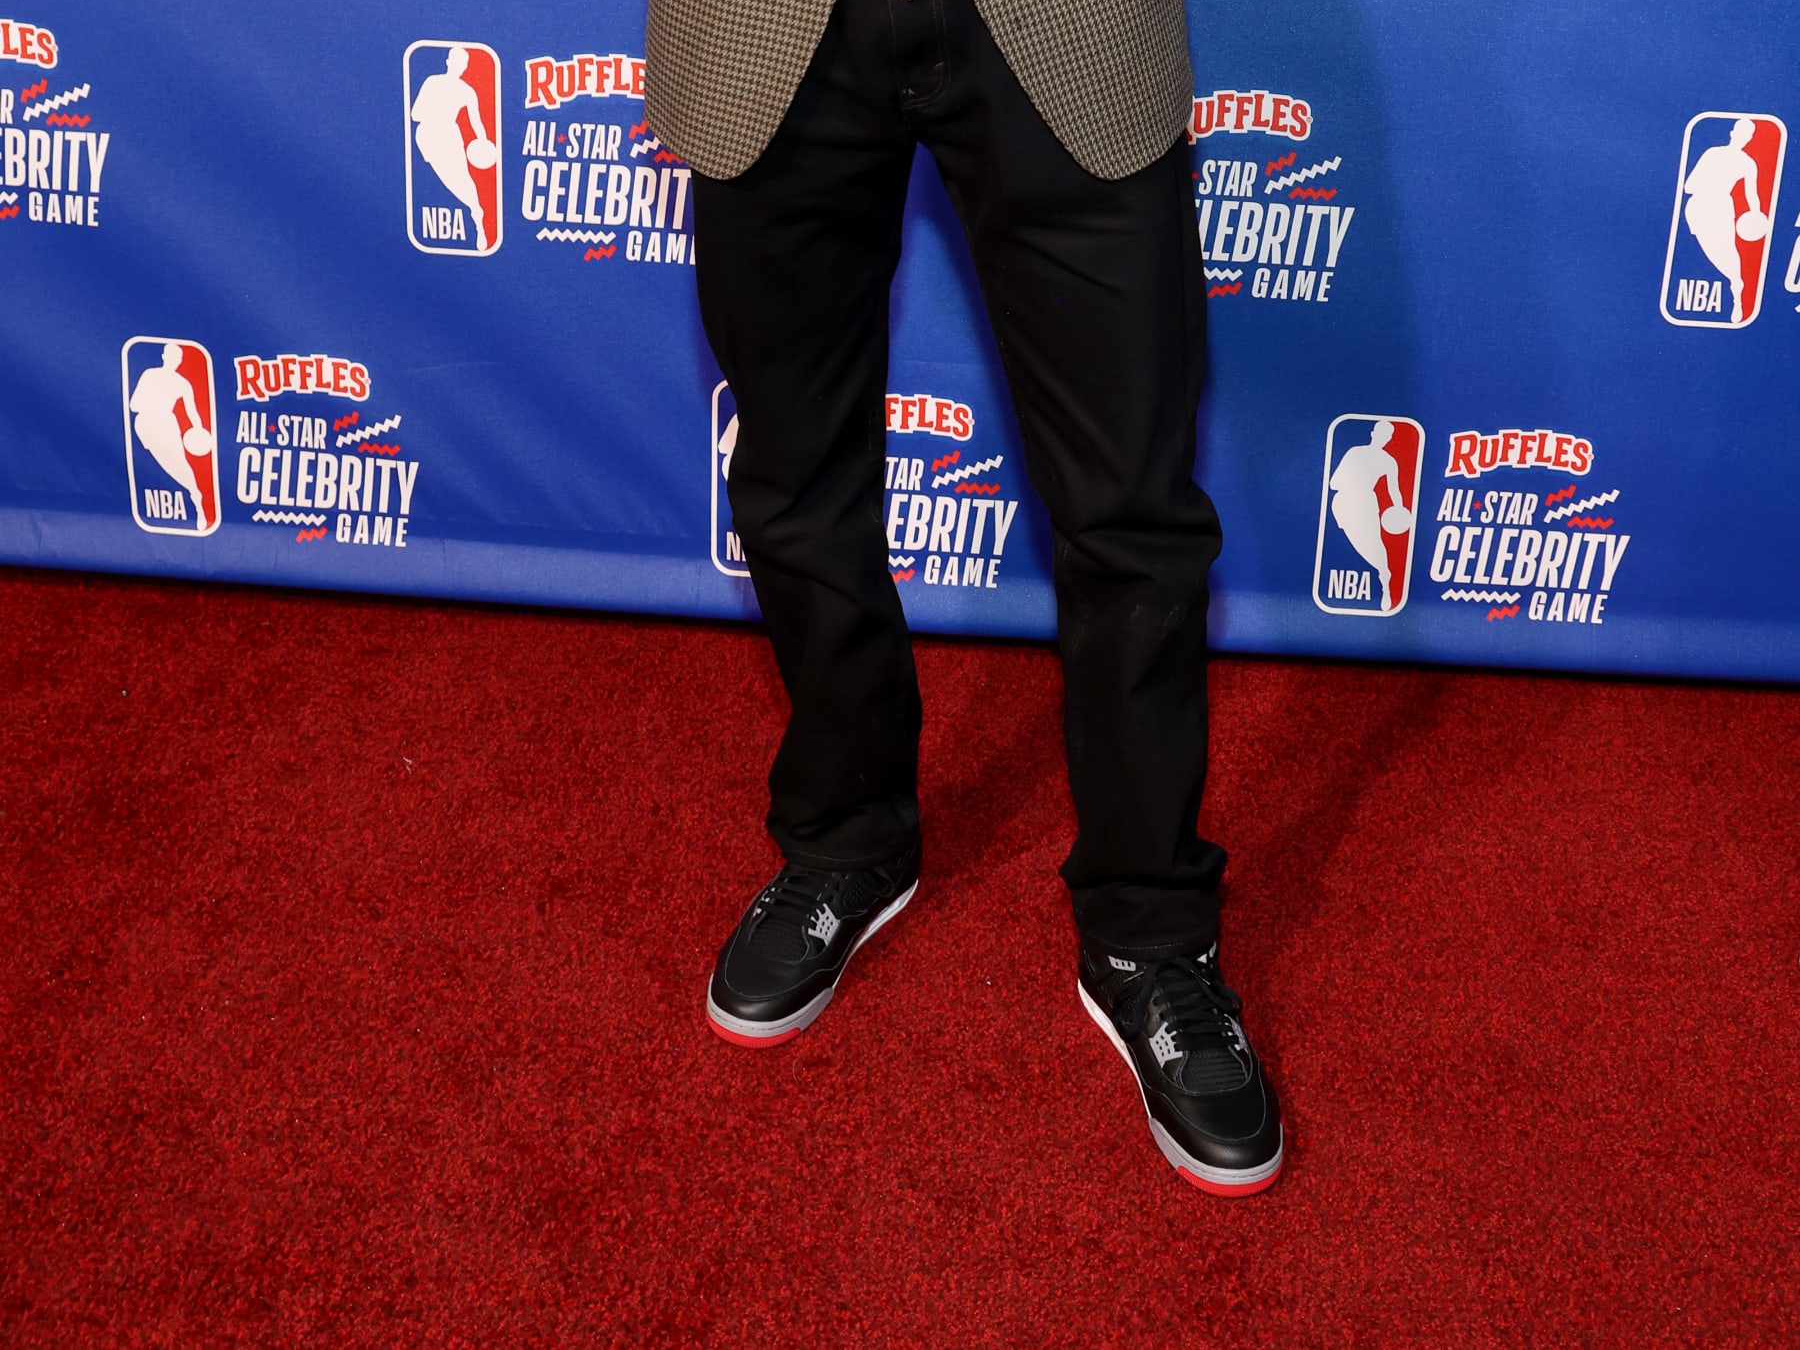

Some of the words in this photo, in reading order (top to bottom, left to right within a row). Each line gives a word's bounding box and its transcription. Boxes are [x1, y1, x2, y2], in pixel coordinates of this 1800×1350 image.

[526, 56, 646, 107] RUFFLE
[1187, 92, 1310, 142] UFFLES
[4, 127, 110, 194] BRITY
[28, 191, 100, 227] GAME
[521, 159, 692, 230] CELEBRIT
[422, 206, 466, 241] NBA
[1198, 199, 1355, 268] LEBRITY
[625, 230, 696, 265] GAM
[1251, 267, 1334, 302] GAME
[1675, 278, 1722, 313] NBA
[236, 355, 369, 400] RUFFLES
[886, 396, 972, 439] FFLES
[1446, 431, 1592, 476] RUFFLES
[236, 446, 419, 515] CELEBRITY
[885, 456, 925, 491] TAR
[144, 488, 187, 521] NBA
[335, 513, 409, 548] GAME
[886, 493, 1019, 556] EBRITY
[923, 554, 1001, 589] GAME
[1429, 525, 1631, 591] CELEBRITY
[1327, 569, 1371, 601] NBA
[1528, 590, 1608, 625] GAME
